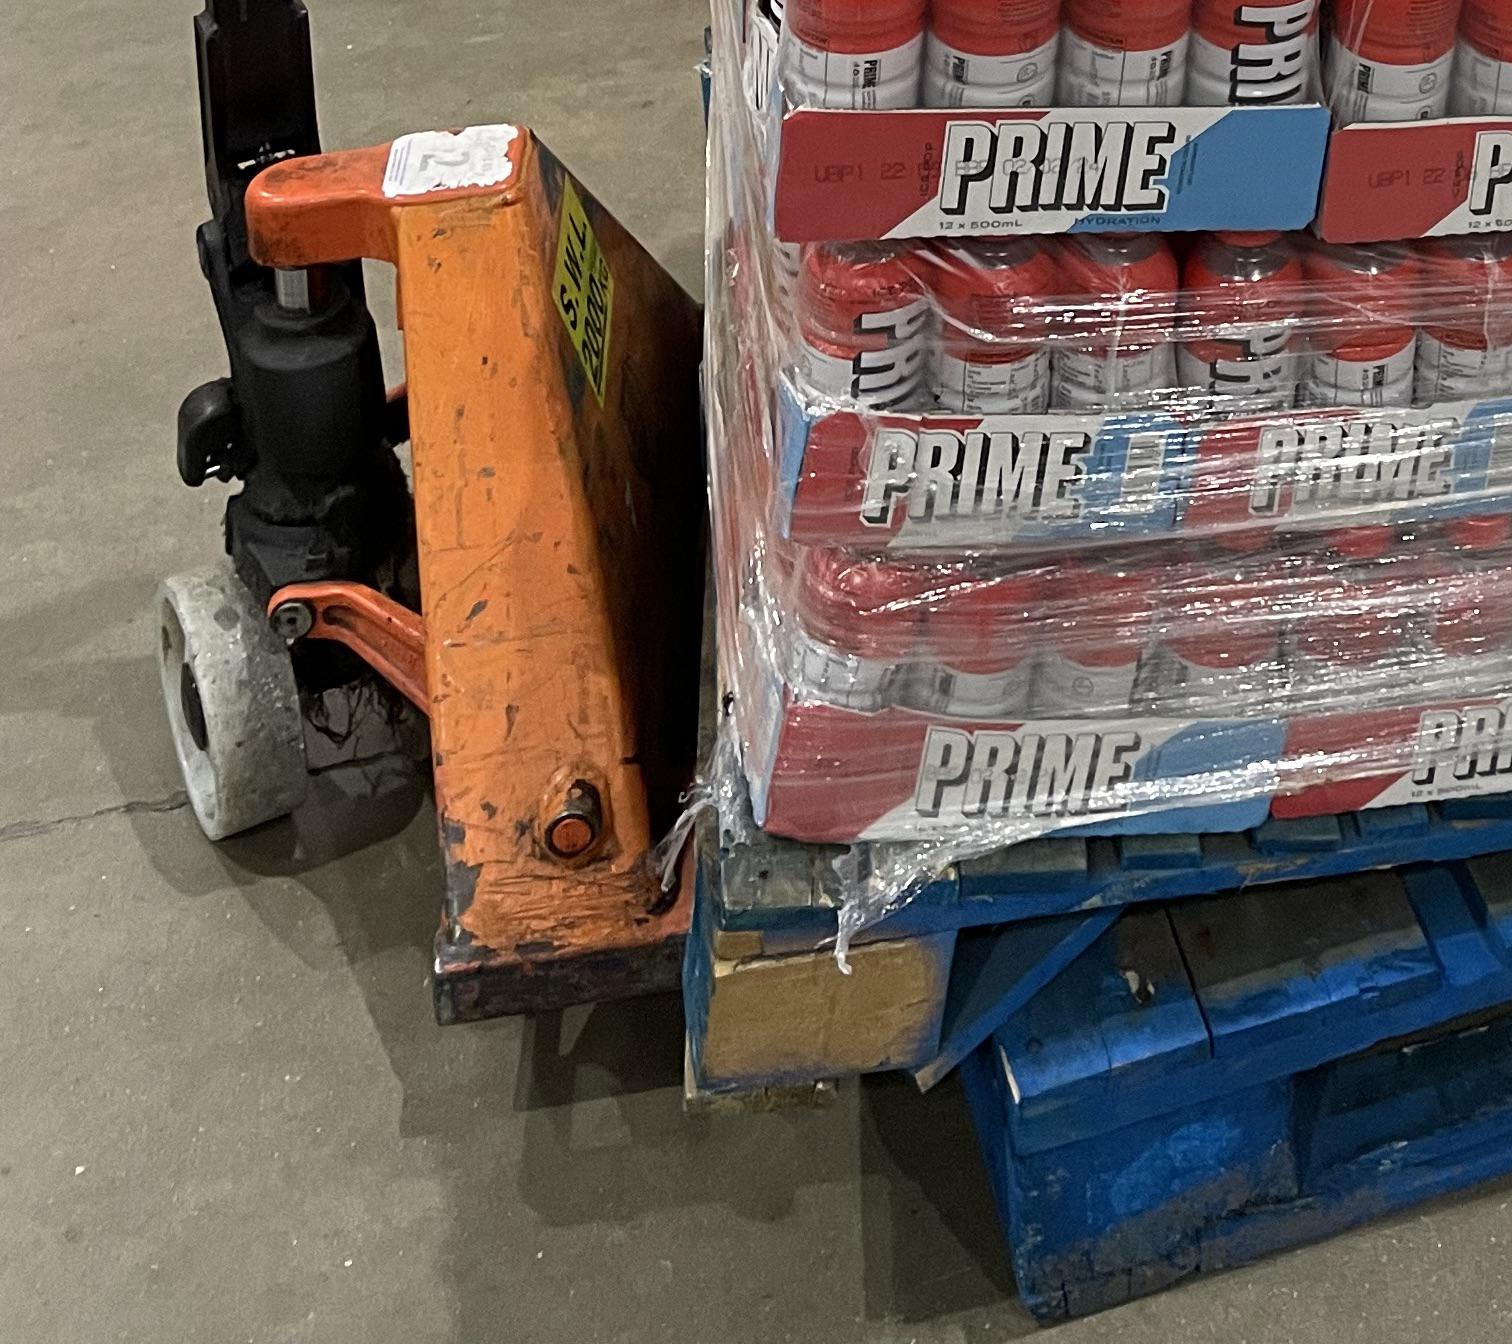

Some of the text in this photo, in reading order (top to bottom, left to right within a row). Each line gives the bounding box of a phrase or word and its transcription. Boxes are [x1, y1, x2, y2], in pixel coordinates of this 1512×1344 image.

[940, 120, 1176, 214] PRIME
[861, 426, 1092, 528] PRIME
[1250, 416, 1460, 515] PRIME
